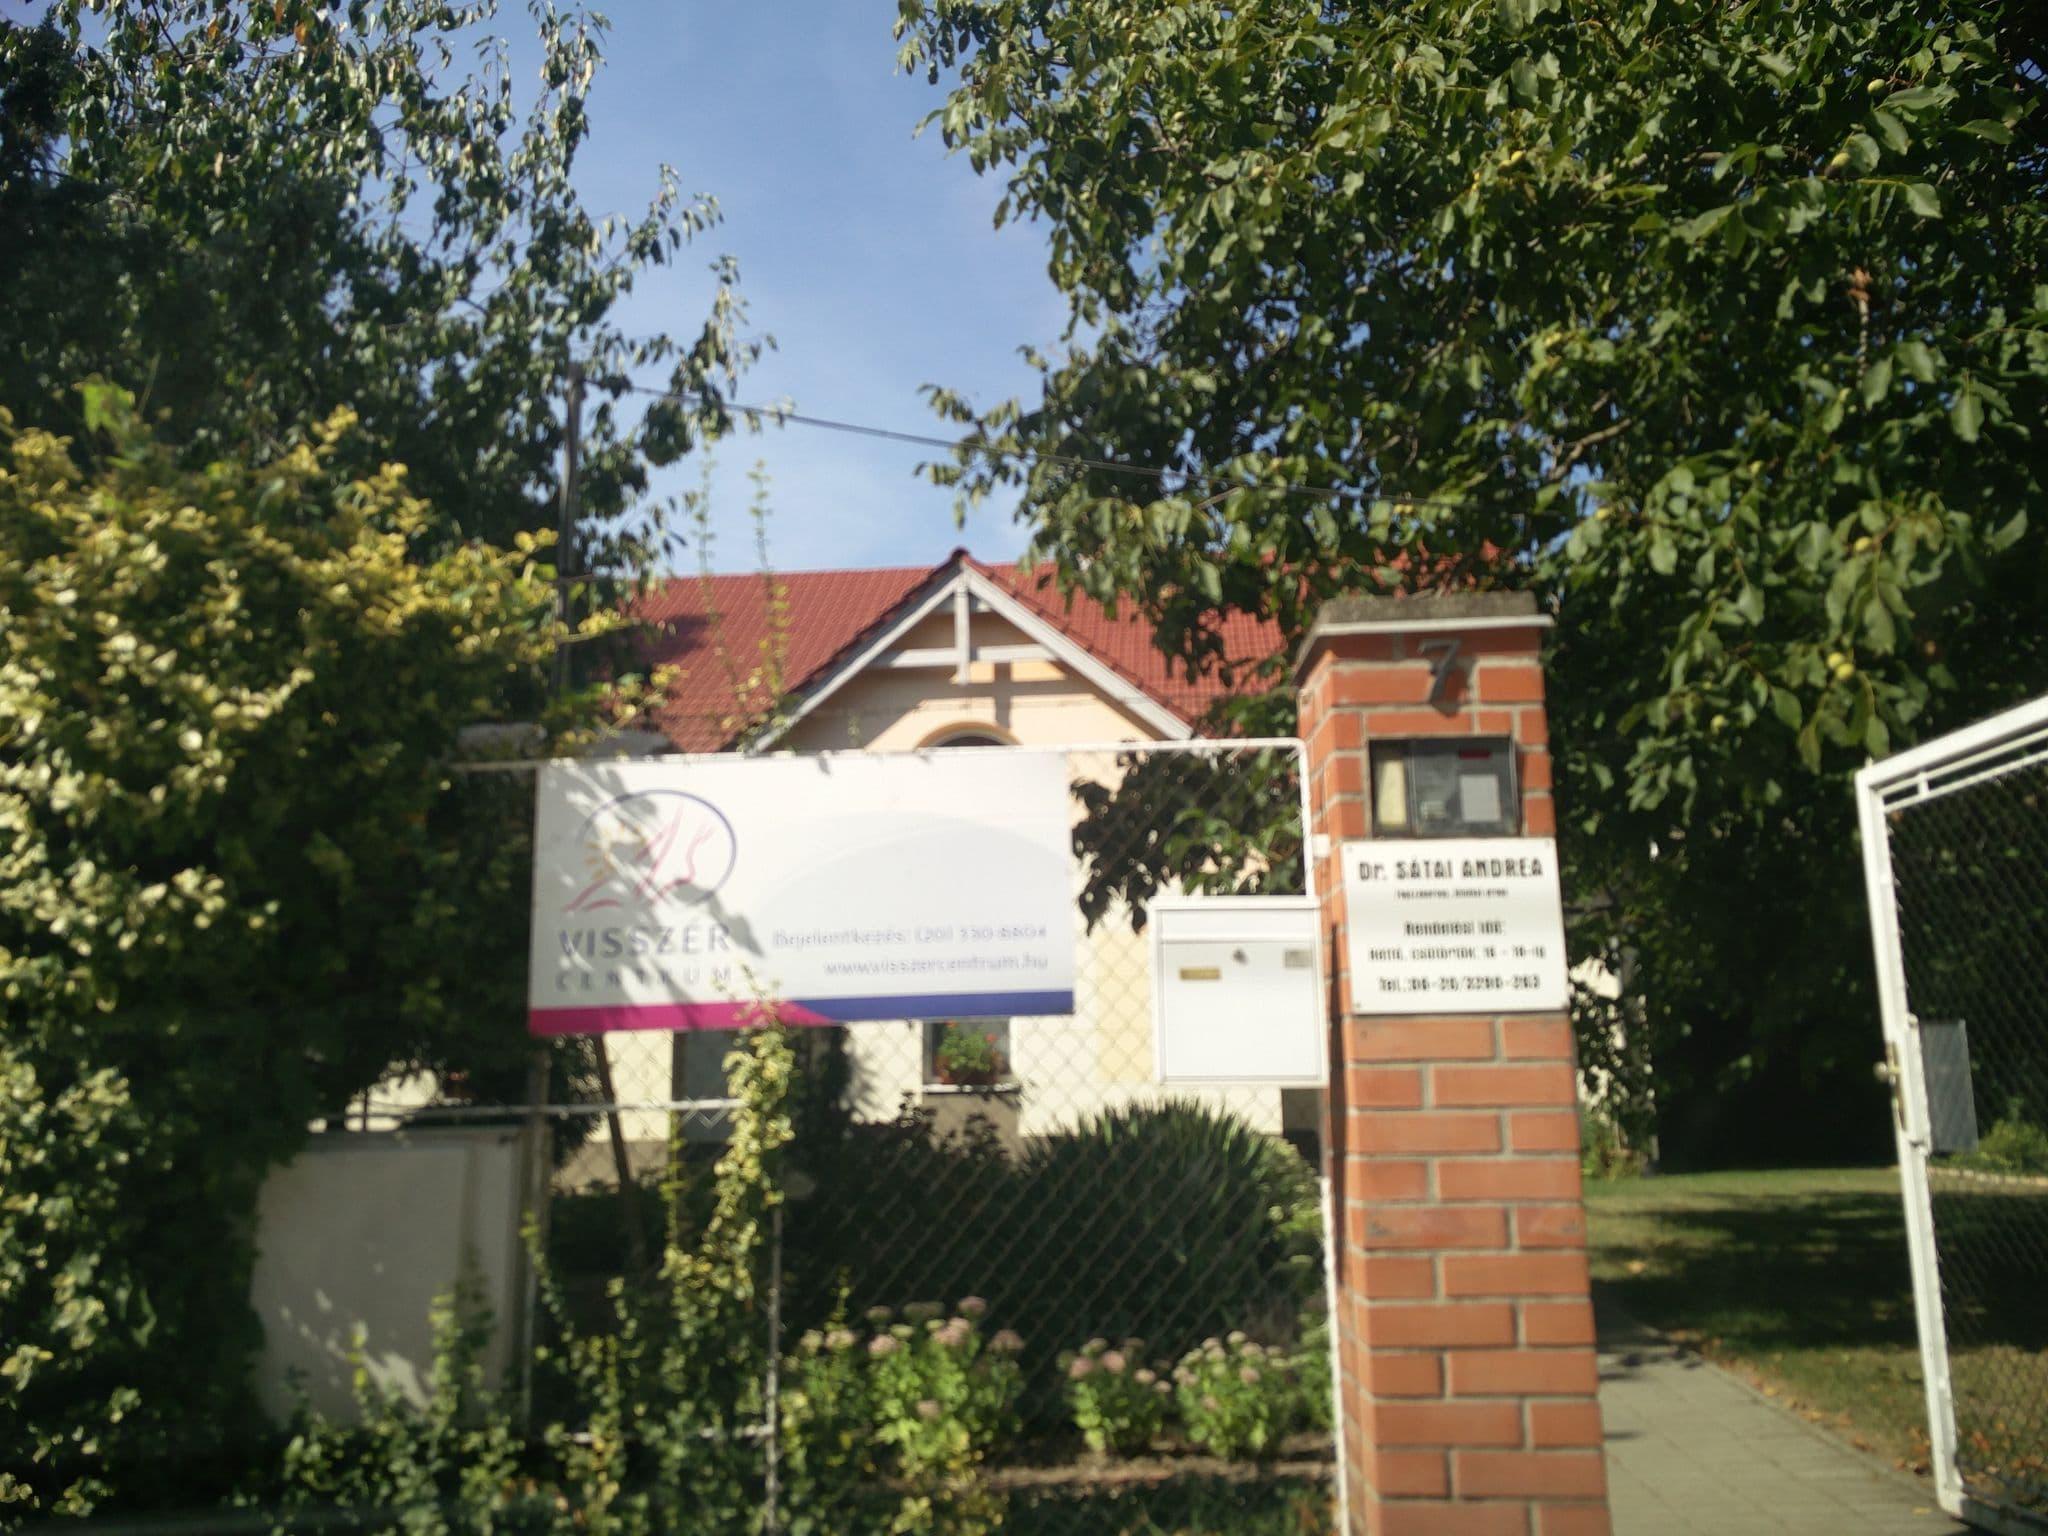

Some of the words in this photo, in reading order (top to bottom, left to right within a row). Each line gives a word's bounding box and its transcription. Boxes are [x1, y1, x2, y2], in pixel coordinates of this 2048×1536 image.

[1358, 862, 1387, 881] Dr.
[1396, 856, 1453, 880] SÁTAI
[1462, 858, 1543, 879] ANDREA
[558, 917, 731, 958] VISSZÉR
